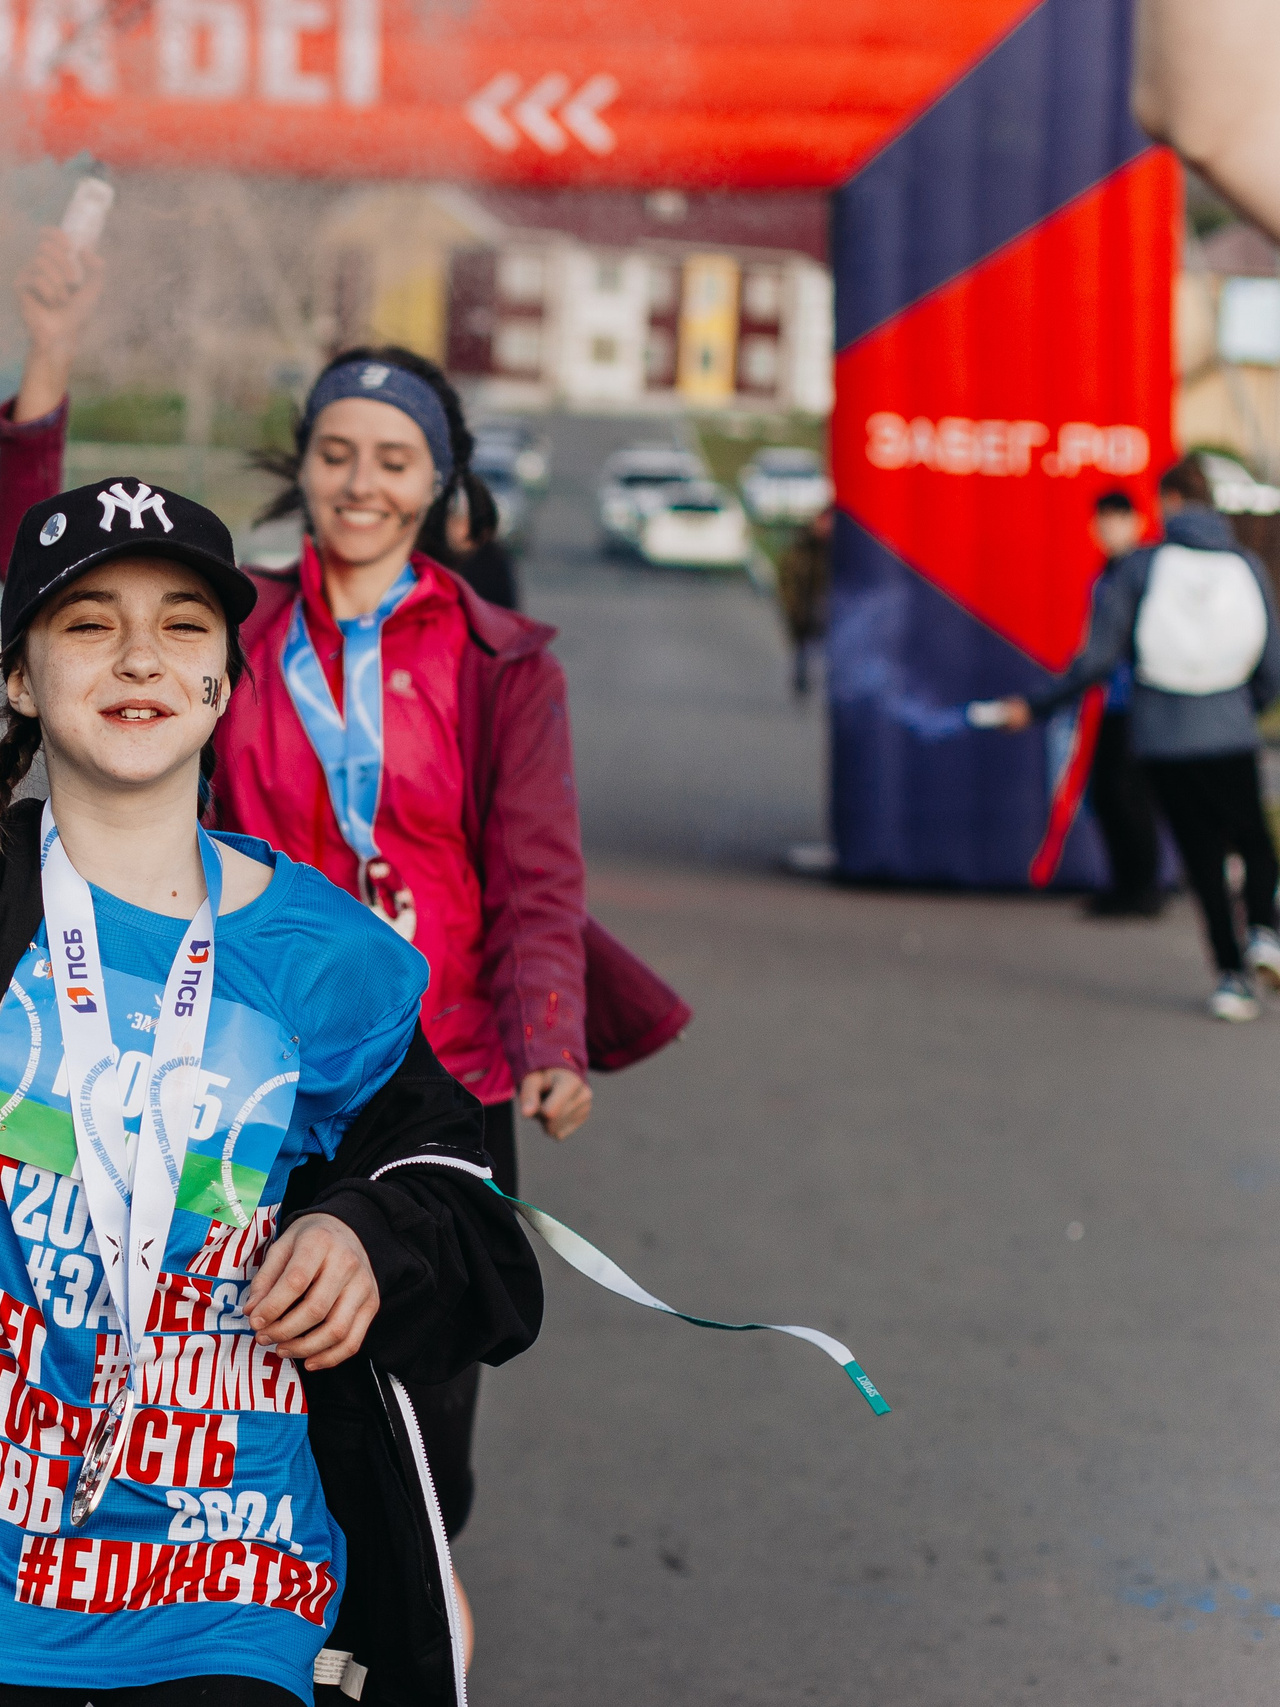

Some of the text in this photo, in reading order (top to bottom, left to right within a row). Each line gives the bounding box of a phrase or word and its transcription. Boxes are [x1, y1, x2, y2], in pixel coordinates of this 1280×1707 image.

[865, 412, 1151, 478] ЗАБЕГ.РФ
[63, 928, 88, 980] ПСБ
[174, 970, 202, 1017] ПСБ
[80, 1055, 115, 1101] #УДИВЛЕНИЕ
[150, 1055, 202, 1108] #САМОВЫРАЖЕНИЕ
[81, 1102, 98, 1136] #ТРЕПЕТ
[151, 1109, 172, 1155] #ГОРДОСТЬ
[90, 1136, 120, 1180] #ВОЛНЕНИЕ
[856, 1375, 881, 1398] SPORT
[166, 1490, 303, 1555] 2024
[18, 1535, 337, 1626] #ЕДИНСТВО
